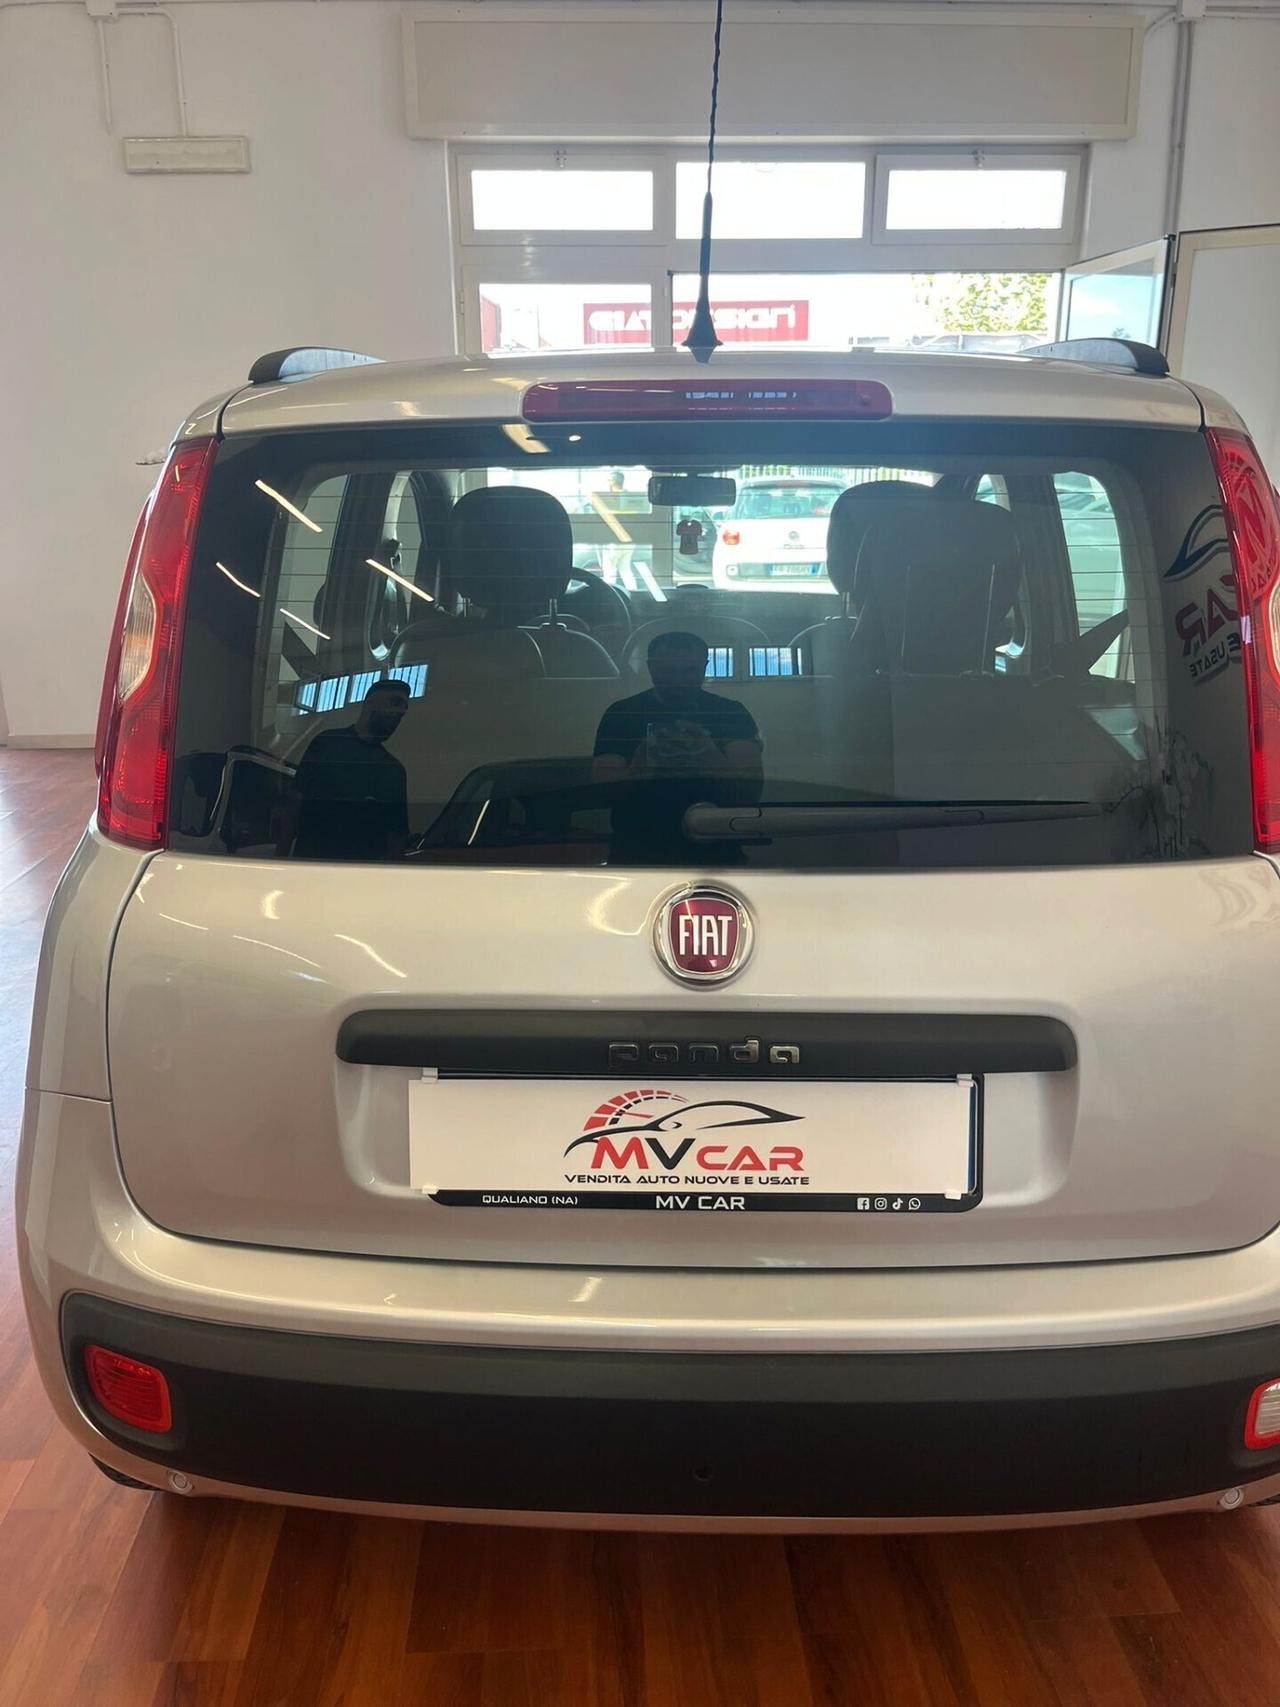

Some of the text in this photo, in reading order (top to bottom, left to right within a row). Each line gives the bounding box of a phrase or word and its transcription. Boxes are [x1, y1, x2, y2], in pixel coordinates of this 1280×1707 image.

[678, 914, 733, 956] FIAT
[608, 1039, 800, 1069] panda
[564, 1174, 811, 1186] VENDITA AUTO NUOVE E USATE
[482, 1195, 578, 1206] QUALIANO (NA)
[655, 1195, 746, 1211] MV CAR
